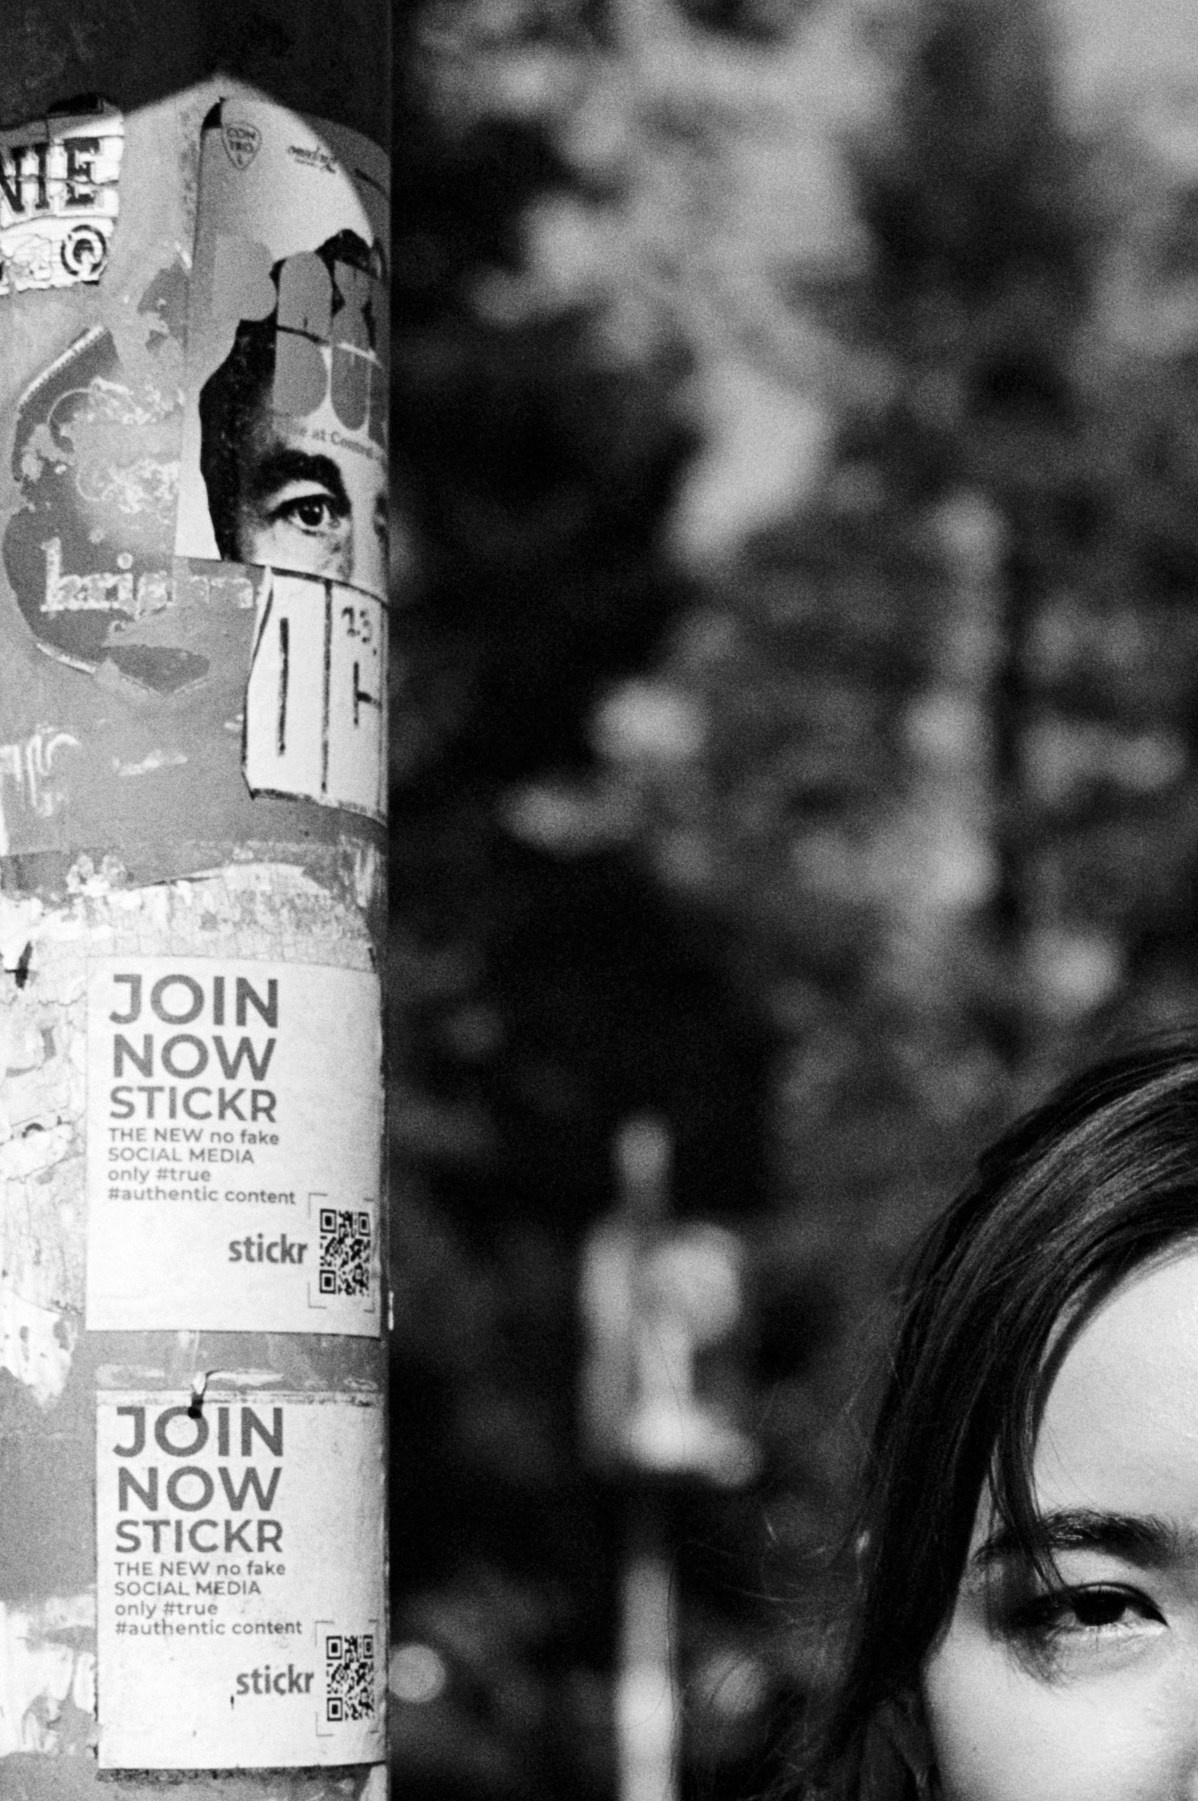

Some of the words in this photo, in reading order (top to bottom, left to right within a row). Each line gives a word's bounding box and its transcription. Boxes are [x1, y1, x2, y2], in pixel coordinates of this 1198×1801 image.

[108, 972, 279, 1029] JOIN
[112, 1032, 277, 1082] NOW
[108, 1085, 278, 1124] STICKR
[108, 1127, 147, 1143] THE
[154, 1127, 203, 1143] NEW
[210, 1129, 234, 1144] no
[240, 1129, 280, 1146] fake
[107, 1146, 183, 1163] SOCIAL
[189, 1147, 255, 1165] MEDIA
[107, 1165, 148, 1184] only
[156, 1166, 212, 1183] #true
[107, 1185, 219, 1202] #authentic
[225, 1187, 296, 1206] content
[228, 1233, 308, 1266] stickr
[112, 1405, 285, 1458] JOIN
[118, 1465, 283, 1513] NOW
[114, 1518, 284, 1554] STICKR
[114, 1561, 153, 1577] THE
[160, 1561, 210, 1577] NEW
[216, 1563, 242, 1577] no
[246, 1561, 286, 1577] fake
[114, 1581, 190, 1596] SOCIAL
[195, 1580, 262, 1597] MEDIA
[114, 1600, 158, 1618] only
[163, 1600, 219, 1617] #true
[114, 1620, 227, 1637] #authentic
[231, 1620, 303, 1636] content
[234, 1664, 315, 1697] stickr
